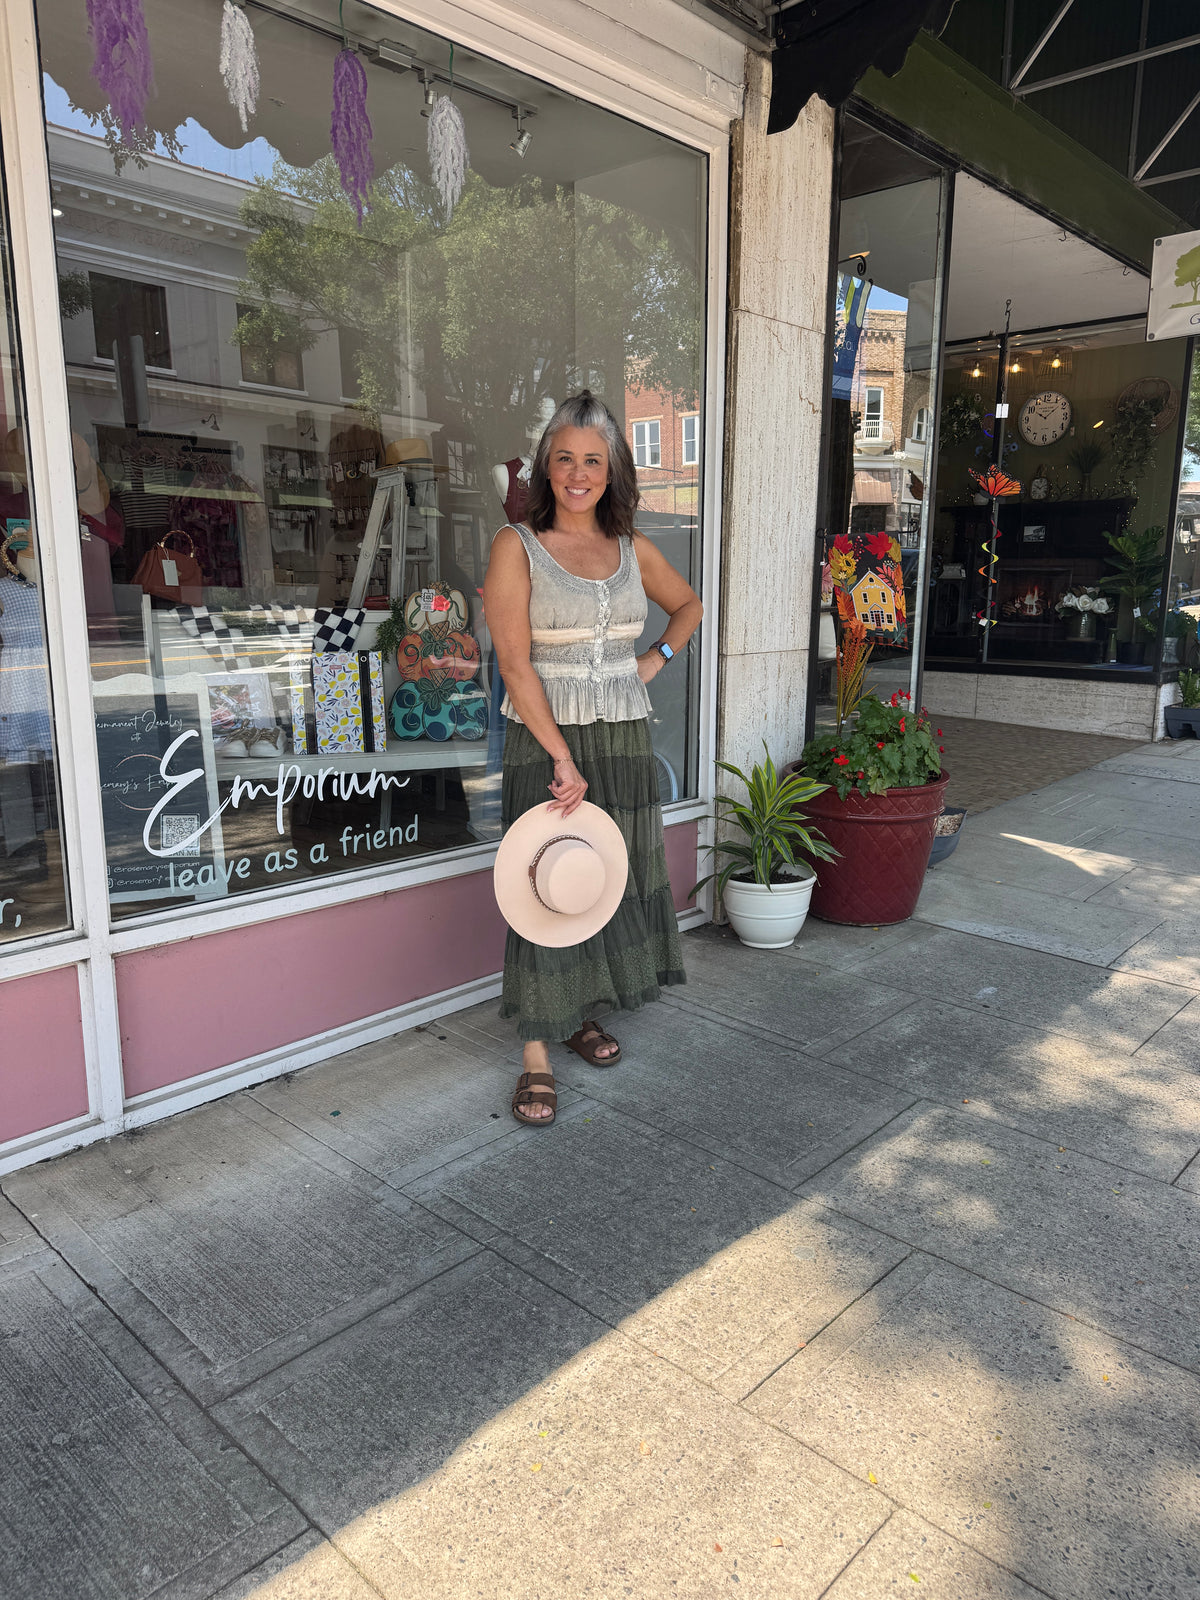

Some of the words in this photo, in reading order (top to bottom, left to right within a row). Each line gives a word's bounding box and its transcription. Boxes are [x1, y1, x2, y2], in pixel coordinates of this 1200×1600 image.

[1043, 393, 1052, 402] 12
[1027, 406, 1036, 414] 10
[1061, 402, 1067, 410] 2
[1024, 416, 1029, 424] 9
[1062, 412, 1068, 420] 3
[1033, 432, 1037, 440] 7
[1042, 434, 1047, 442] 6
[1052, 430, 1057, 438] 5
[143, 729, 410, 857] Emporium
[169, 858, 251, 893] leave
[264, 848, 298, 872] as
[310, 843, 329, 864] a
[339, 814, 419, 857] friend
[113, 861, 200, 873] @rosemaryseporium
